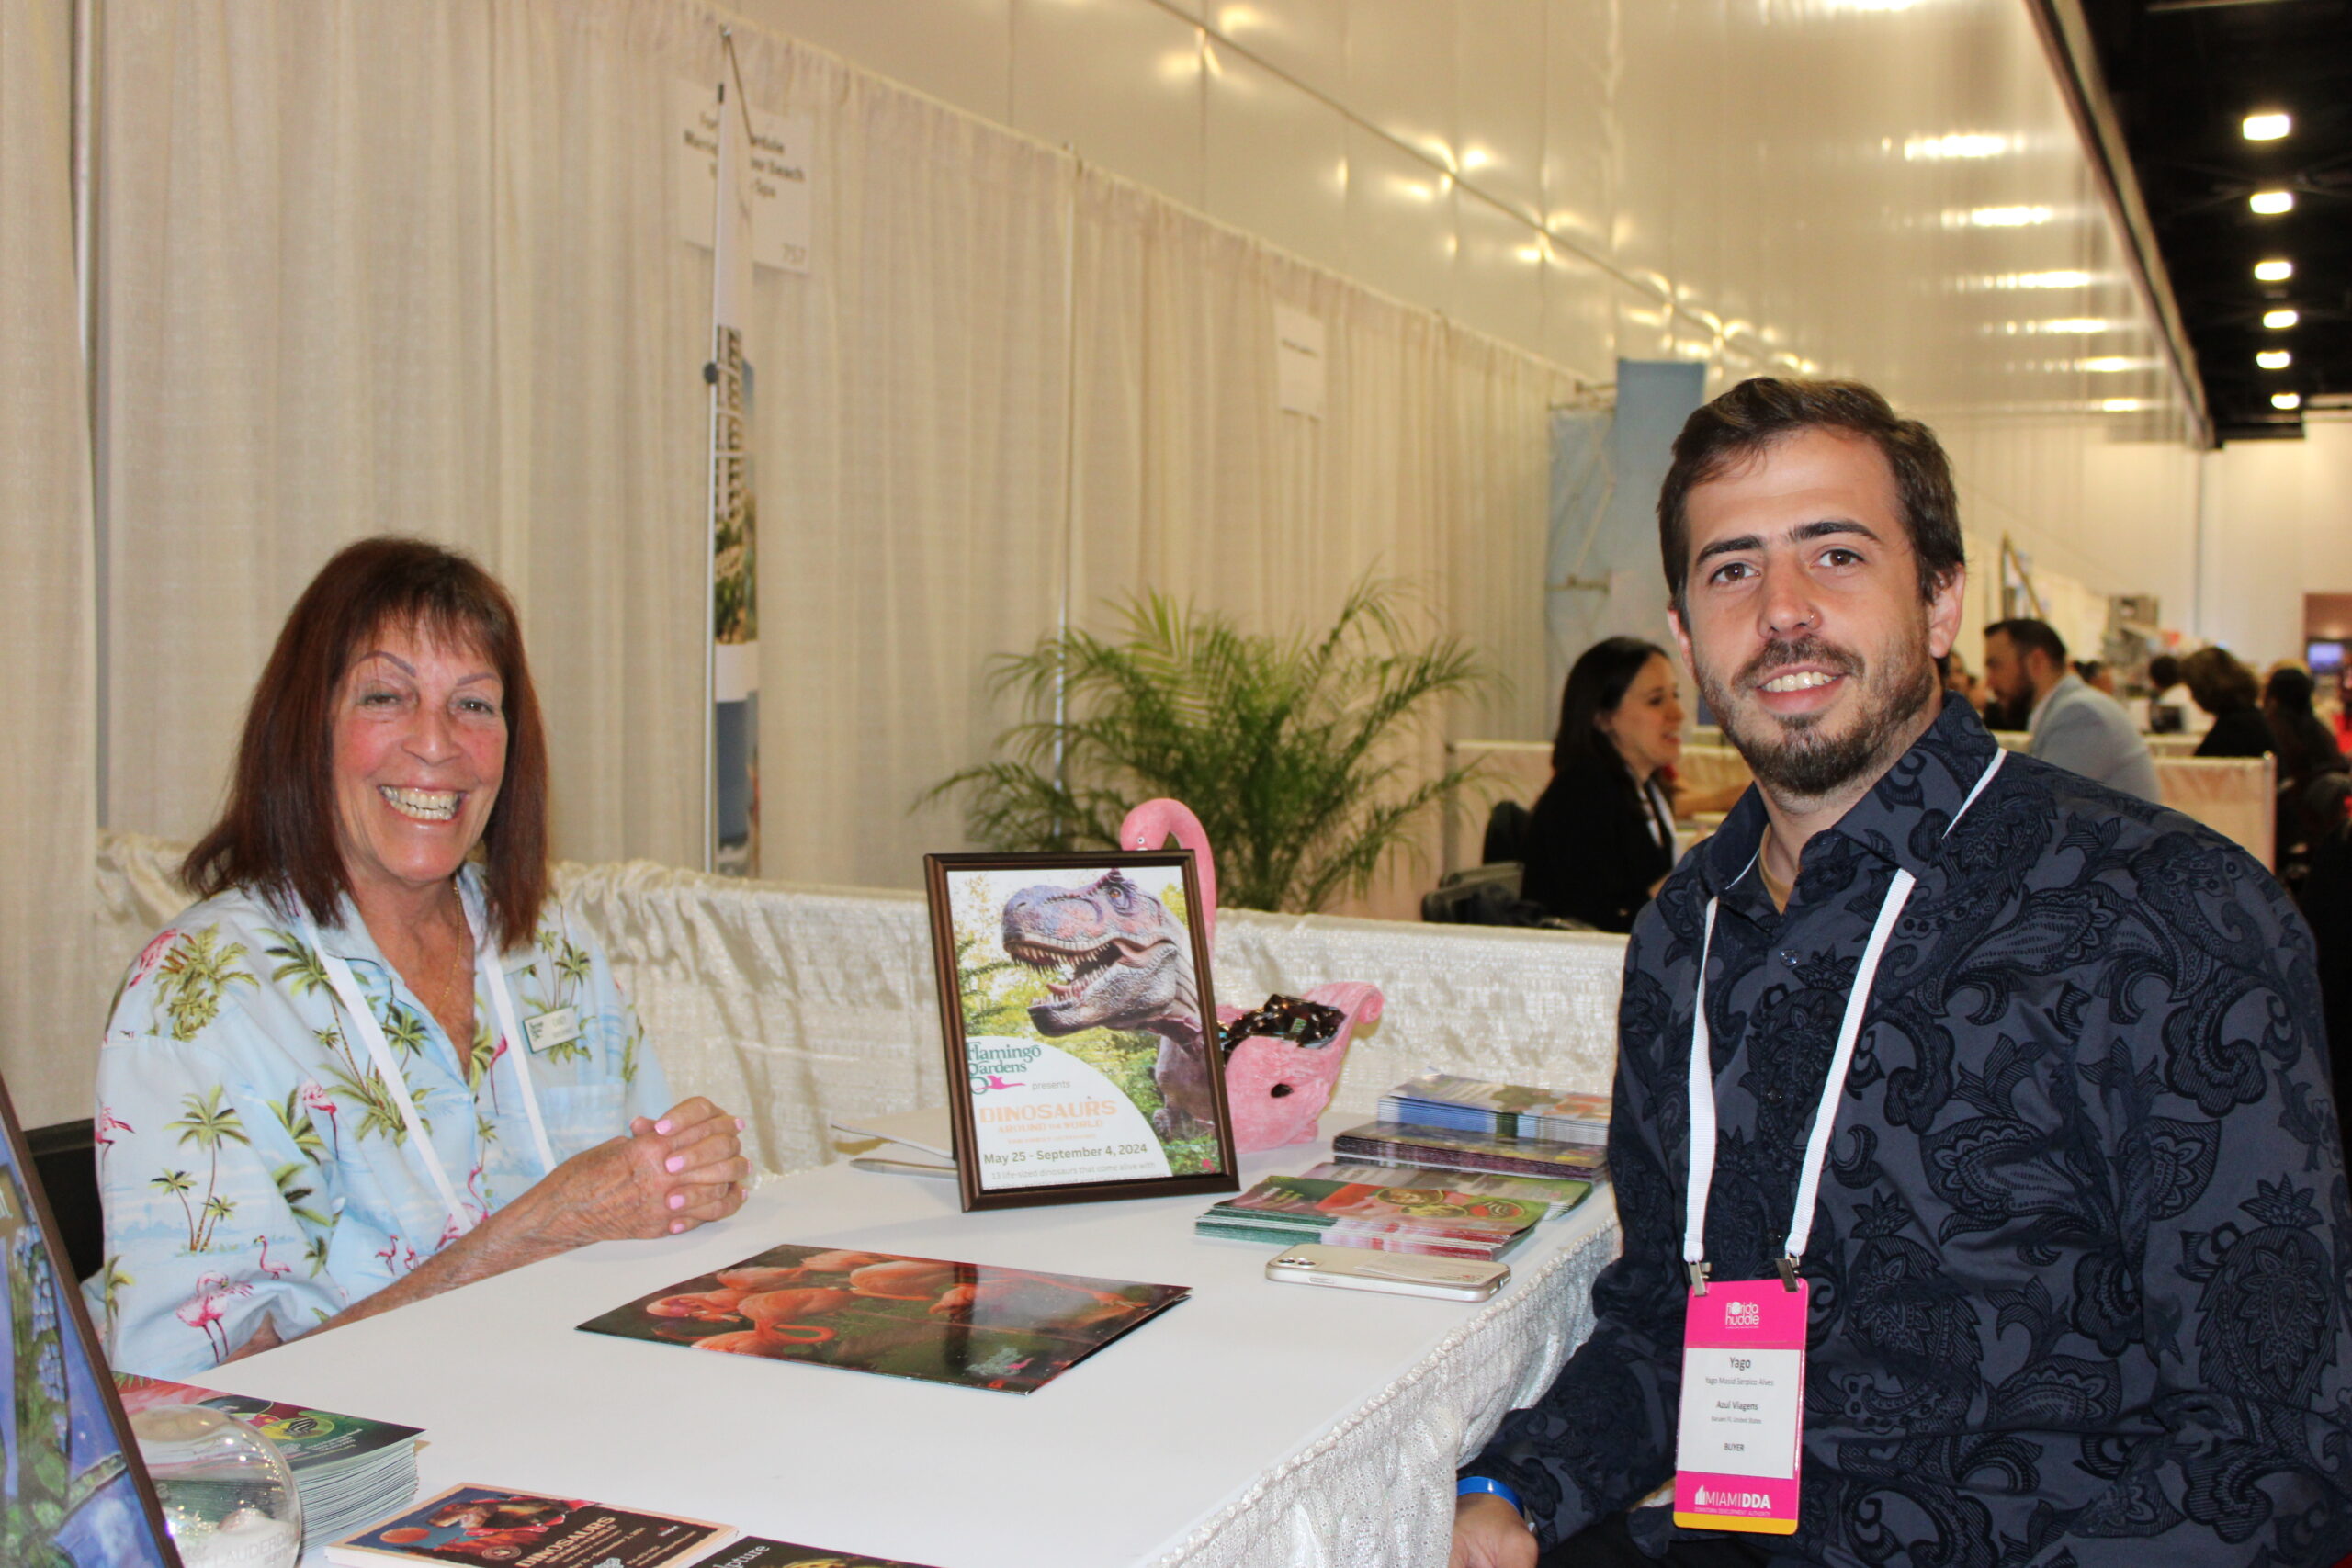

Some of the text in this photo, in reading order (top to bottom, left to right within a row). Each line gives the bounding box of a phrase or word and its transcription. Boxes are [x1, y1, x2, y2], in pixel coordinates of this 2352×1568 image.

[967, 1042, 1042, 1064] Flamingo
[1032, 1080, 1070, 1091] presents
[979, 1100, 1118, 1123] DINOSAURS
[998, 1122, 1046, 1134] AROUND
[1063, 1119, 1103, 1130] WORLD
[983, 1153, 1009, 1166] May
[1012, 1150, 1026, 1162] 25
[1036, 1146, 1102, 1163] September
[1105, 1145, 1116, 1157] 4,
[1119, 1143, 1148, 1155] 2024
[991, 1161, 1156, 1180] 13 life-sized dinosaurs that come alive with
[1725, 1314, 1760, 1325] huddle
[1729, 1357, 1751, 1371] Yago
[1716, 1400, 1758, 1412] Azul Viagens
[1724, 1442, 1745, 1451] BUYER
[514, 1516, 616, 1568] DINOSAURS
